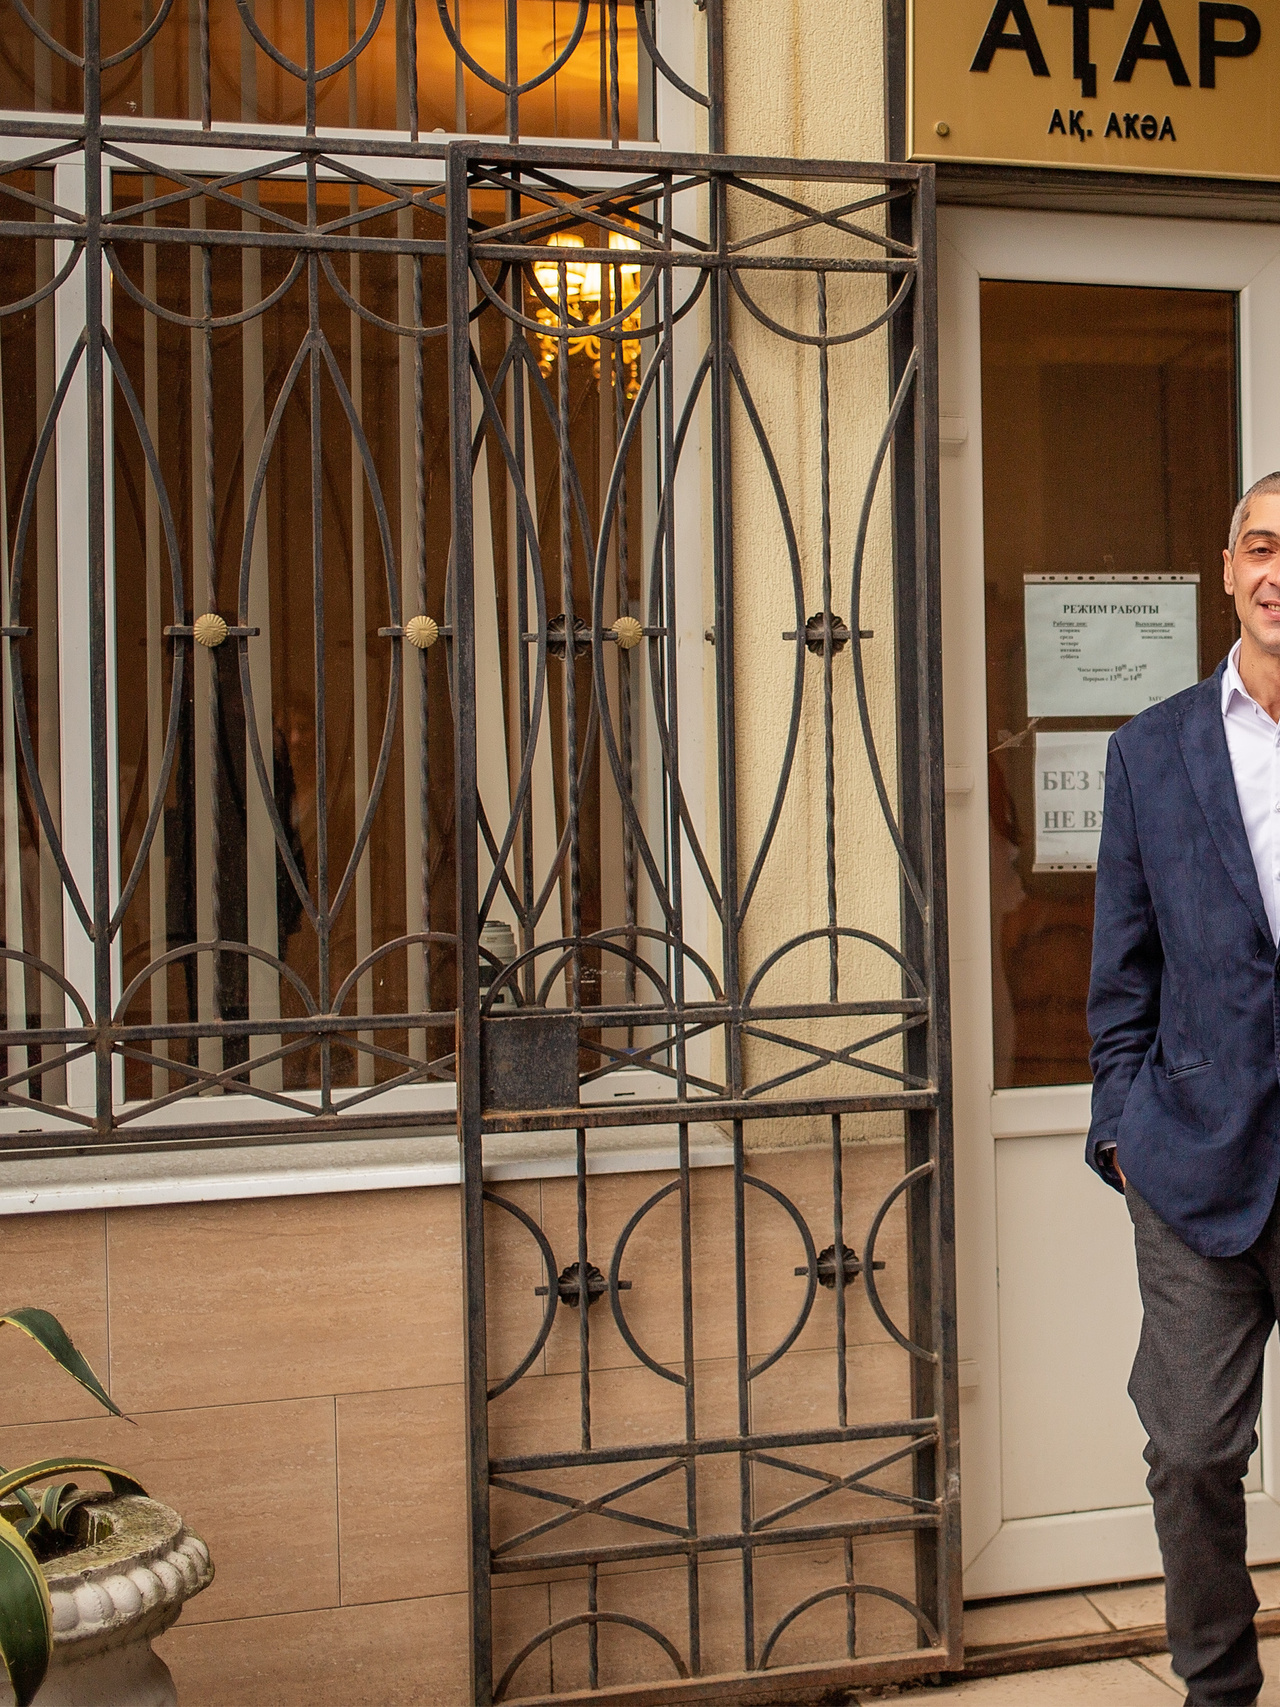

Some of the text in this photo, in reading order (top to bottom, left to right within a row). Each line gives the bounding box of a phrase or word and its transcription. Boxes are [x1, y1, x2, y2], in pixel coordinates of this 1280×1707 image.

[1063, 604, 1159, 614] РЕЖИМ РАБОТЫ
[1042, 770, 1090, 790] БЕЗ
[1044, 810, 1076, 828] НЕ
